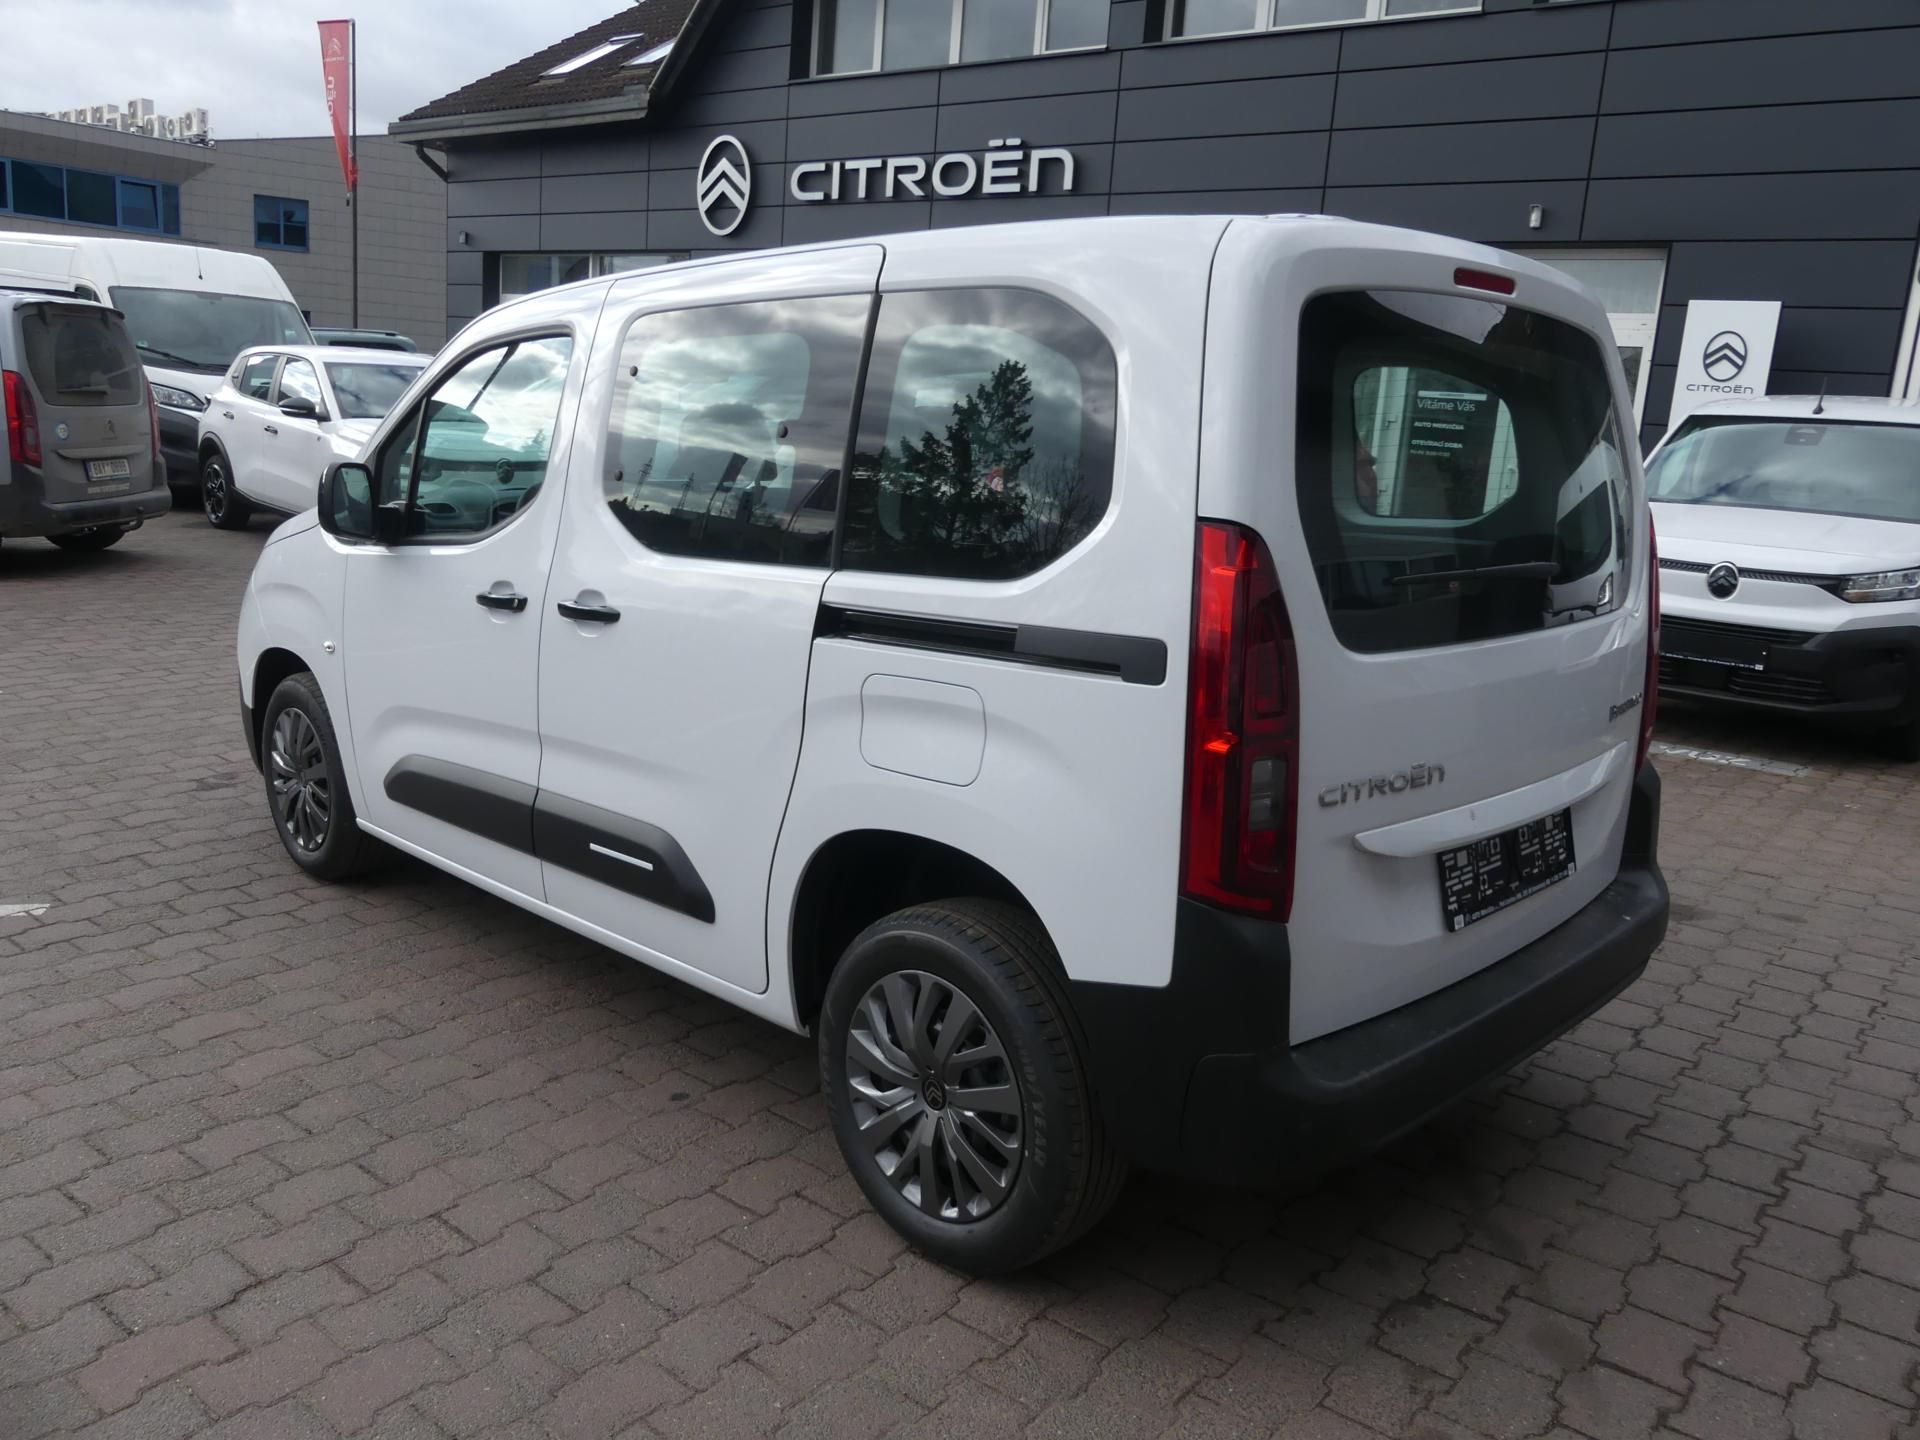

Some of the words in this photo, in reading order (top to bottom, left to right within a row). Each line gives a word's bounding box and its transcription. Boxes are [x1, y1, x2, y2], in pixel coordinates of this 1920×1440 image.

[790, 138, 1074, 201] CITROËN
[1686, 384, 1754, 394] CITROËN
[1456, 400, 1476, 412] Vás
[1317, 762, 1446, 807] CITROËN
